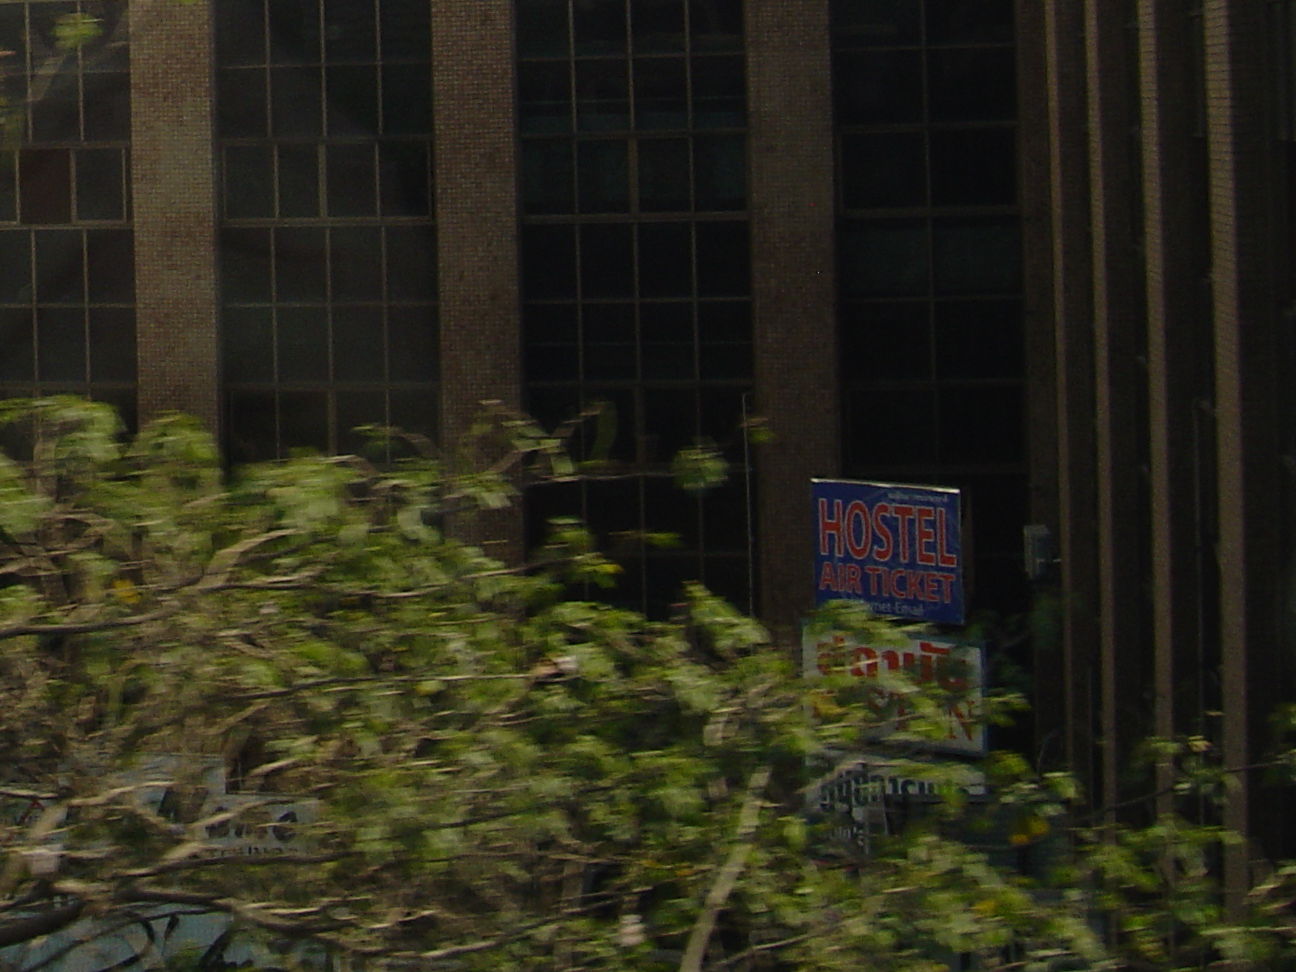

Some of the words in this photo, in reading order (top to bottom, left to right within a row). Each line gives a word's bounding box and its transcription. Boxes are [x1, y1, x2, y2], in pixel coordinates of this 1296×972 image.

[818, 497, 957, 568] HOSTEL
[819, 562, 862, 594] AIR
[864, 565, 957, 604] TICKET
